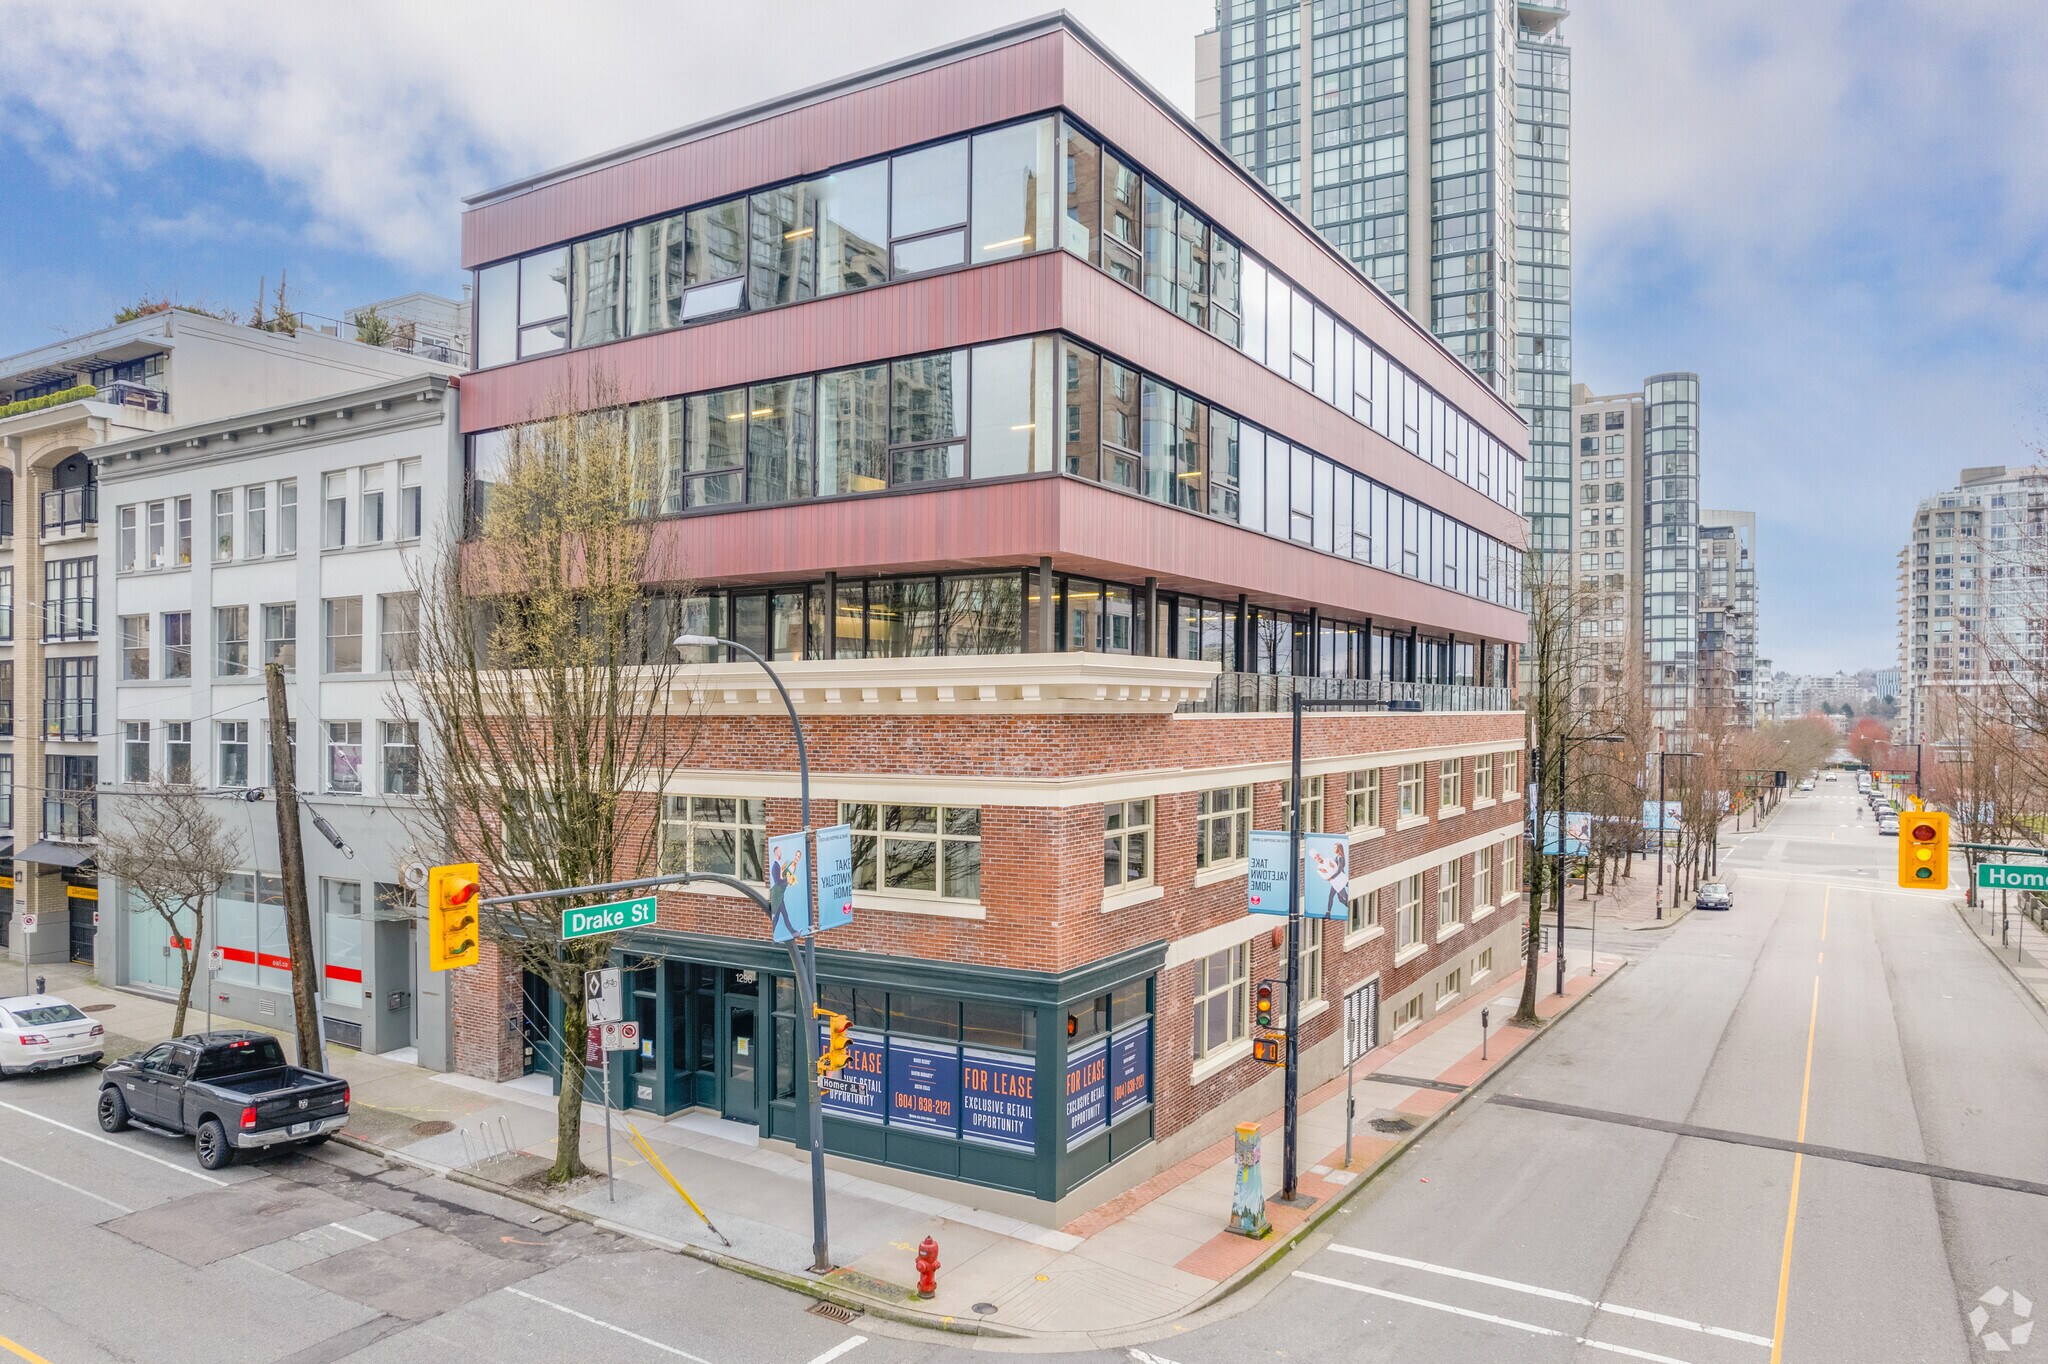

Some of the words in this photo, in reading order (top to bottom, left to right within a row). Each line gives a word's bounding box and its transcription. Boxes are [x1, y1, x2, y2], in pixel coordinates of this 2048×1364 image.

[836, 858, 851, 872] TAKE
[821, 872, 852, 888] YALETOWN
[1990, 868, 2048, 886] Hom
[834, 885, 852, 900] HOME
[572, 910, 624, 932] Drake
[632, 904, 648, 922] St
[736, 974, 752, 984] 1296
[848, 1049, 882, 1074] LEASE
[824, 1078, 848, 1091] Homer
[964, 1068, 988, 1092] FOR
[994, 1072, 1033, 1099] LEASE
[1066, 1069, 1080, 1096] FOR
[1084, 1058, 1105, 1088] LEASE
[1066, 1092, 1090, 1116] EXCLUSIVE
[1090, 1086, 1105, 1103] RETAIL
[1114, 1082, 1126, 1102] (604)
[895, 1092, 916, 1111] (604)
[918, 1096, 951, 1116] 638-2121
[964, 1096, 1004, 1115] EXCLUSIVE
[1006, 1102, 1032, 1120] RETAIL
[1072, 1102, 1100, 1129] OPPORTUNITY
[972, 1112, 1024, 1134] OPPORTUNITY
